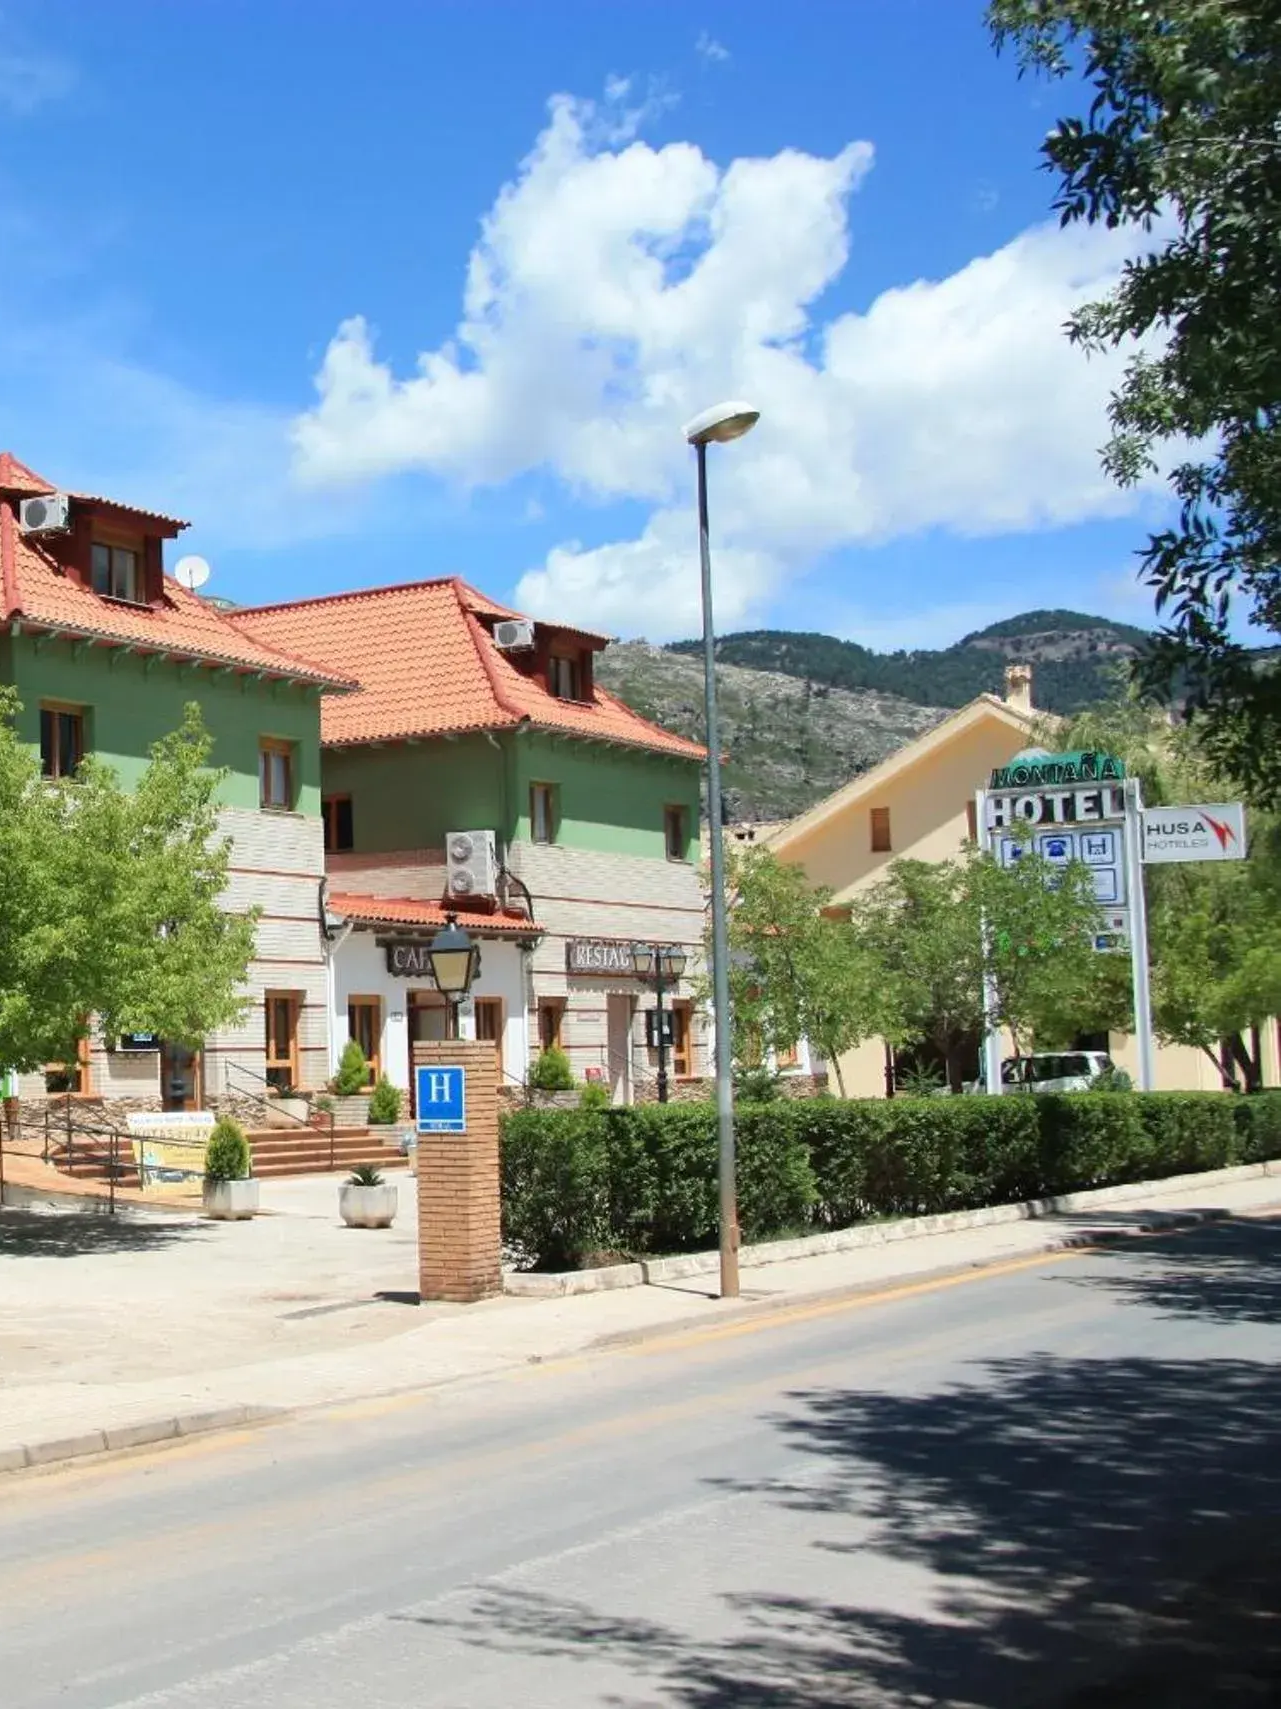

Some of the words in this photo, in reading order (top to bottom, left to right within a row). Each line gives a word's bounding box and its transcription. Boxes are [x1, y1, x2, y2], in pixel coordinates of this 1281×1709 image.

[989, 752, 1120, 789] MONTAÑA
[986, 788, 1124, 827] HOTEL
[1146, 822, 1207, 836] HUSA
[1147, 839, 1209, 851] HOTELES
[428, 1073, 453, 1104] H
